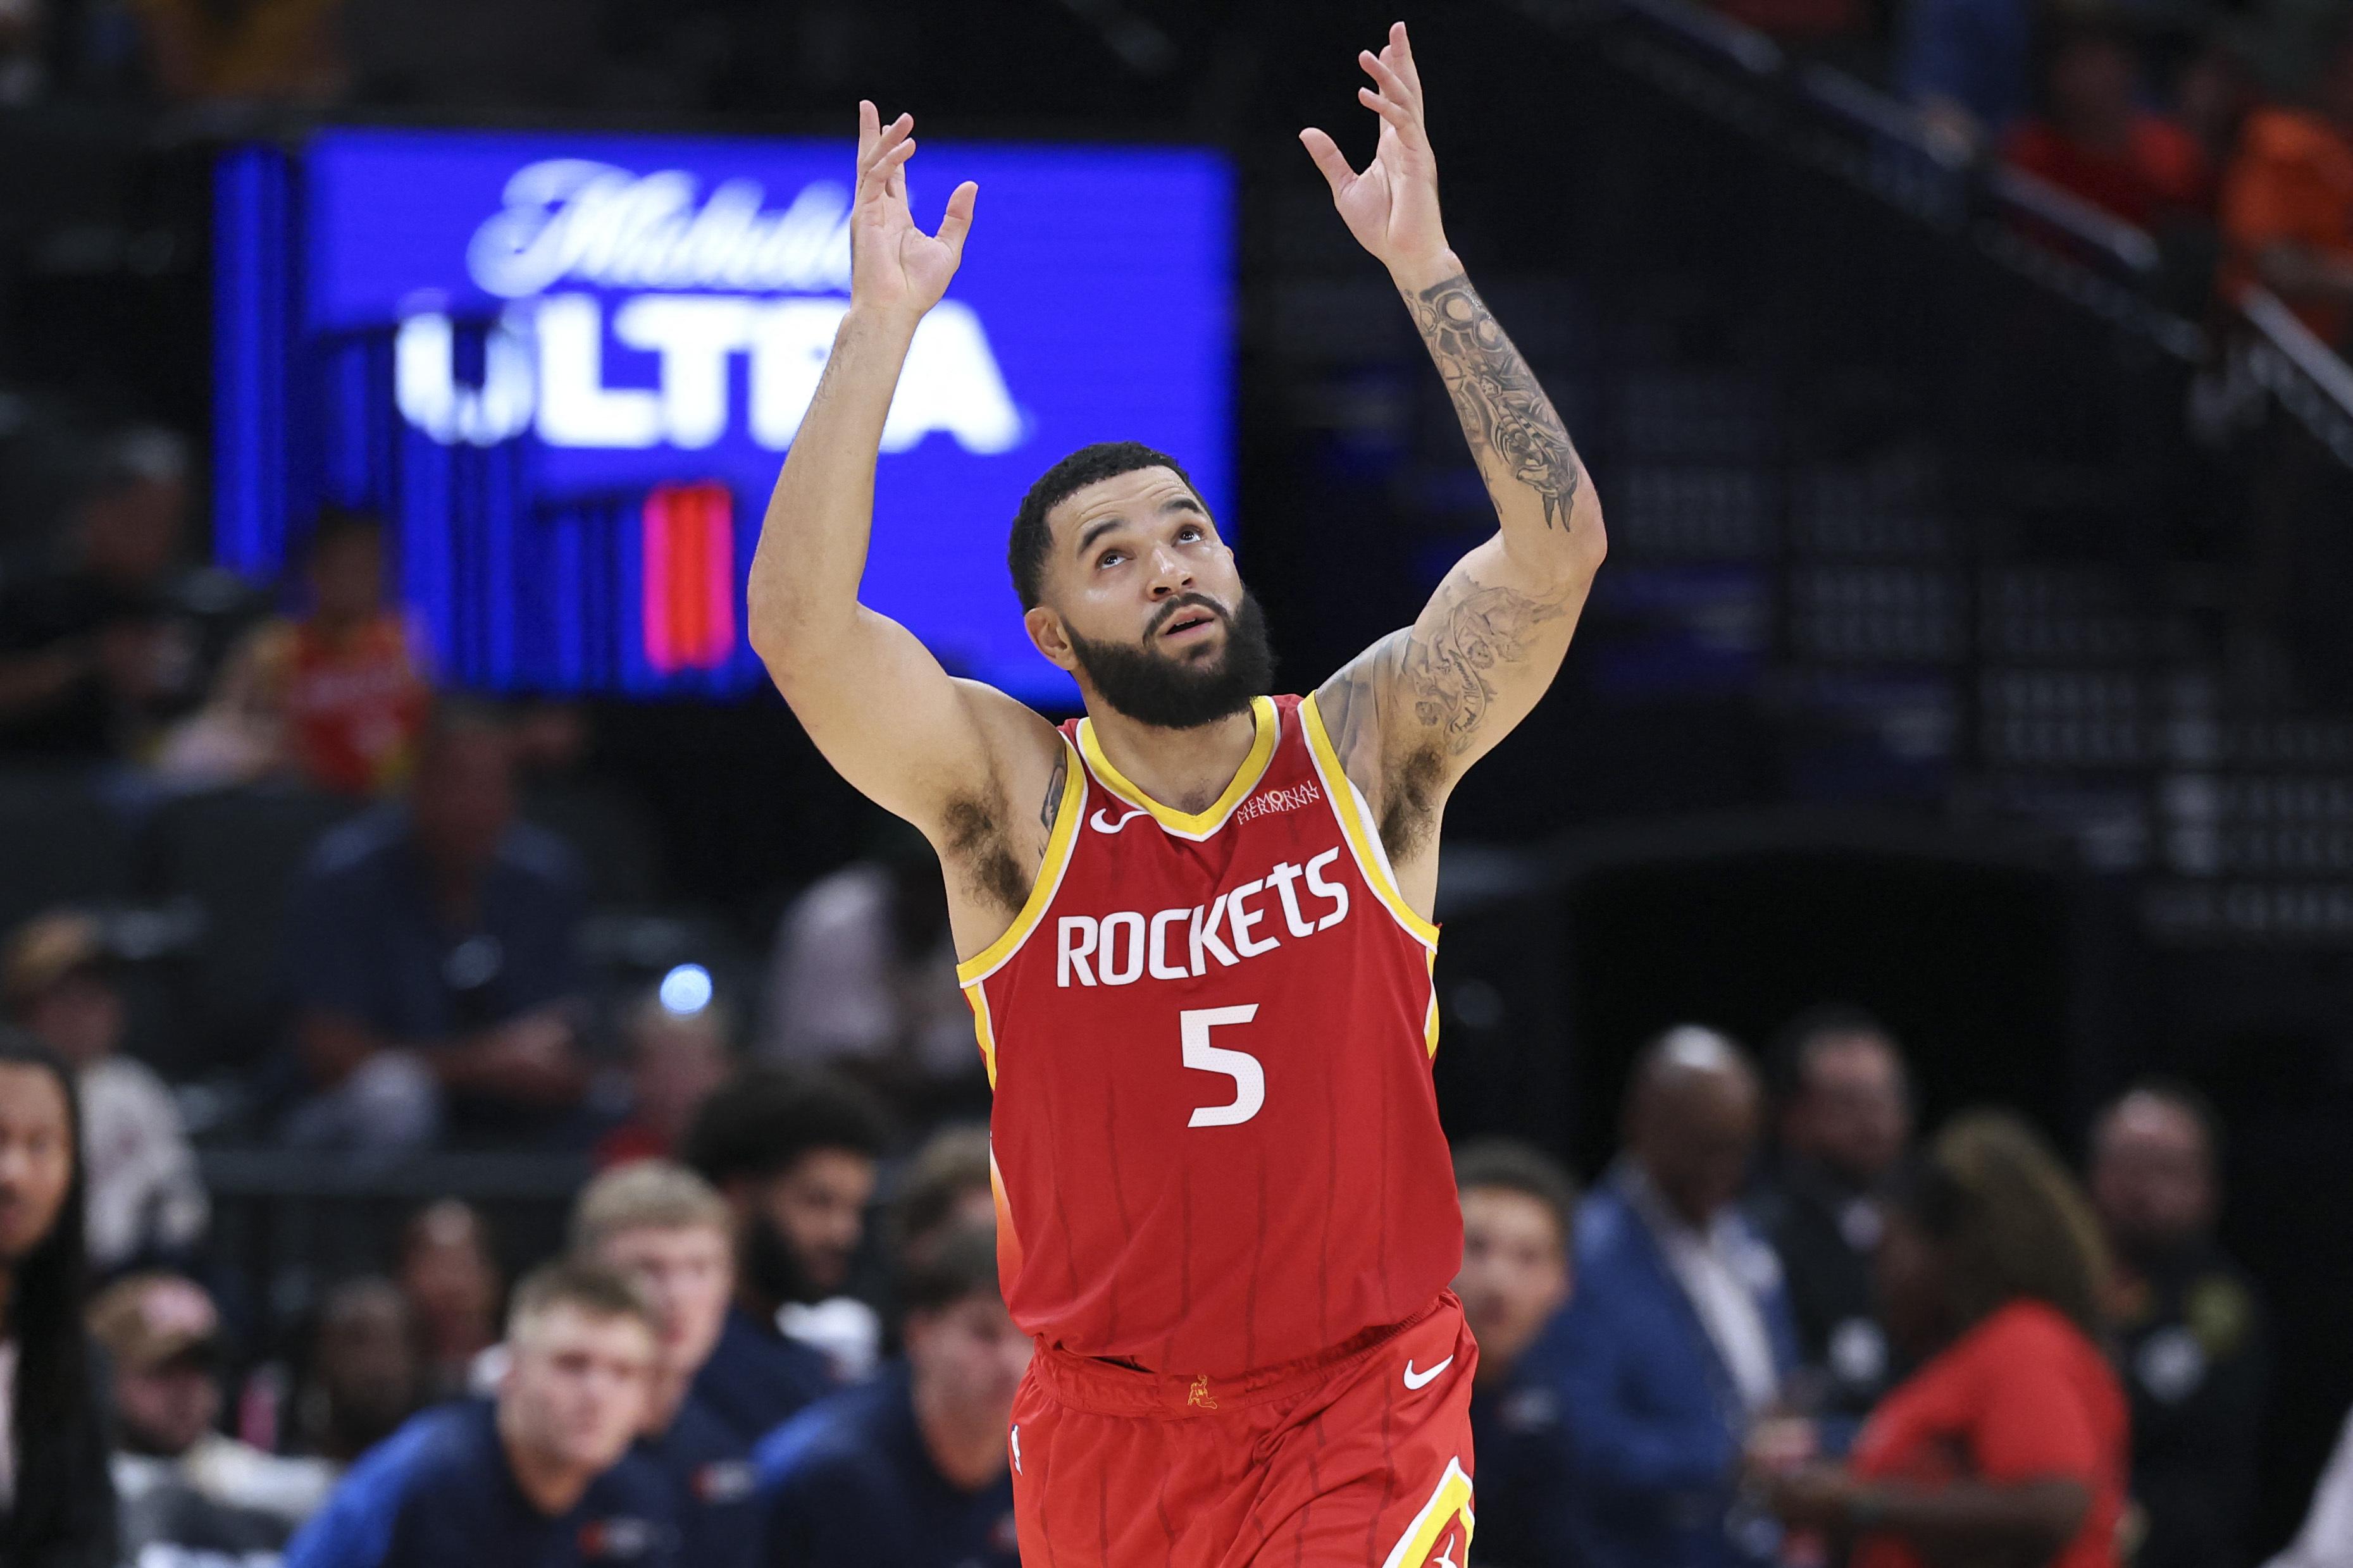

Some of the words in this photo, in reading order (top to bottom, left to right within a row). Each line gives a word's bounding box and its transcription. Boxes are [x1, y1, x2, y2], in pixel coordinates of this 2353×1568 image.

[1237, 780, 1317, 817] MEMORIAL
[1238, 789, 1320, 825] HERMANN
[1180, 1003, 1265, 1128] 5
